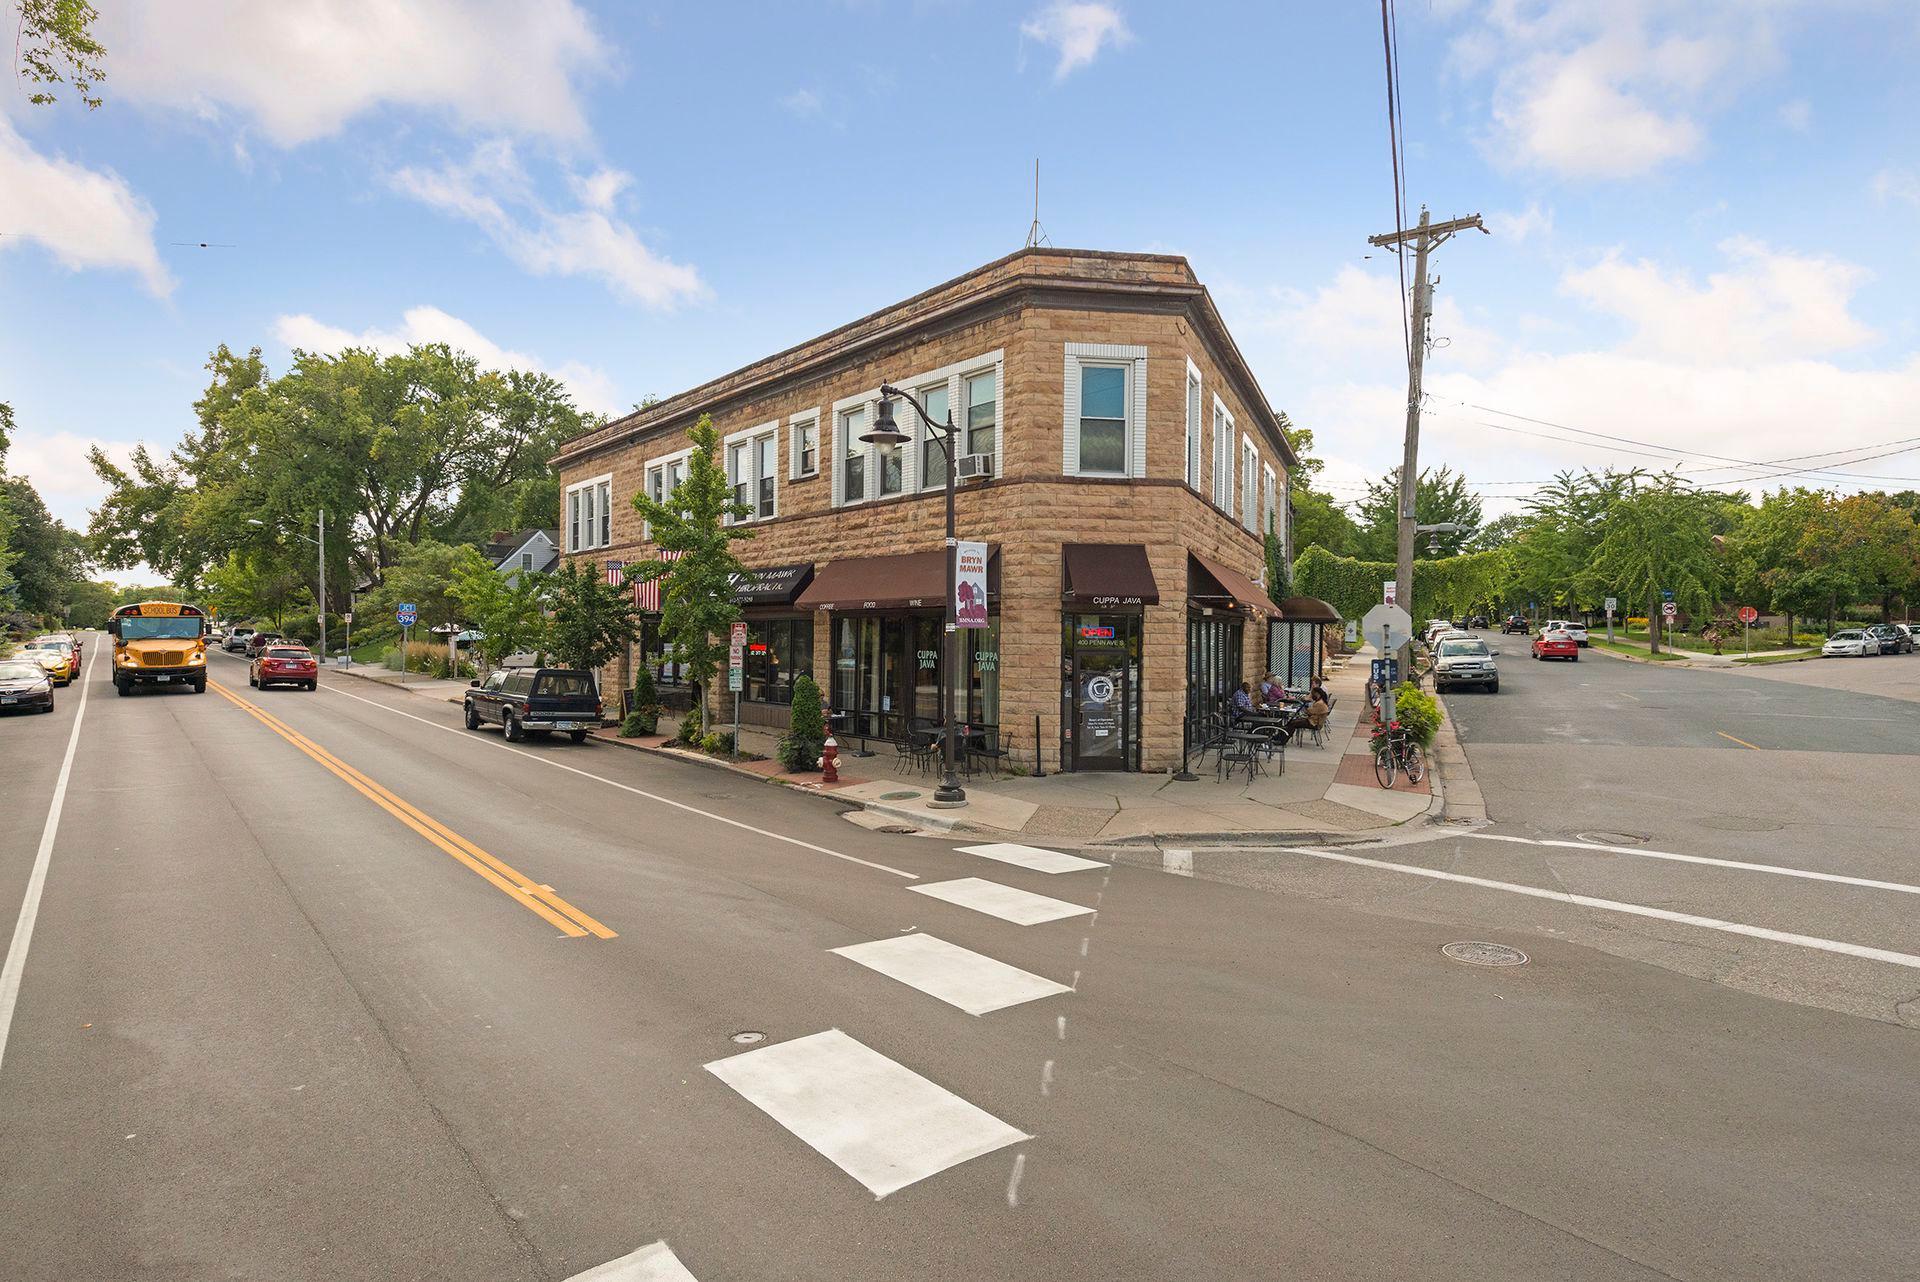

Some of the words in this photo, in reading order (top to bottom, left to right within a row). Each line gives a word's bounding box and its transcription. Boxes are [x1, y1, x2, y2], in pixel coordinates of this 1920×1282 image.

[961, 556, 982, 564] BRYN
[960, 564, 983, 573] MAWR
[863, 601, 876, 609] FOOD
[909, 599, 922, 607] WINE
[143, 606, 165, 615] SCHOOL
[167, 606, 178, 615] BUS
[399, 615, 415, 623] 394
[1081, 627, 1112, 637] OPEN
[917, 650, 938, 659] CUPPA
[975, 651, 999, 661] CUPPA
[919, 659, 935, 670] JAVA
[978, 661, 996, 672] JAVA
